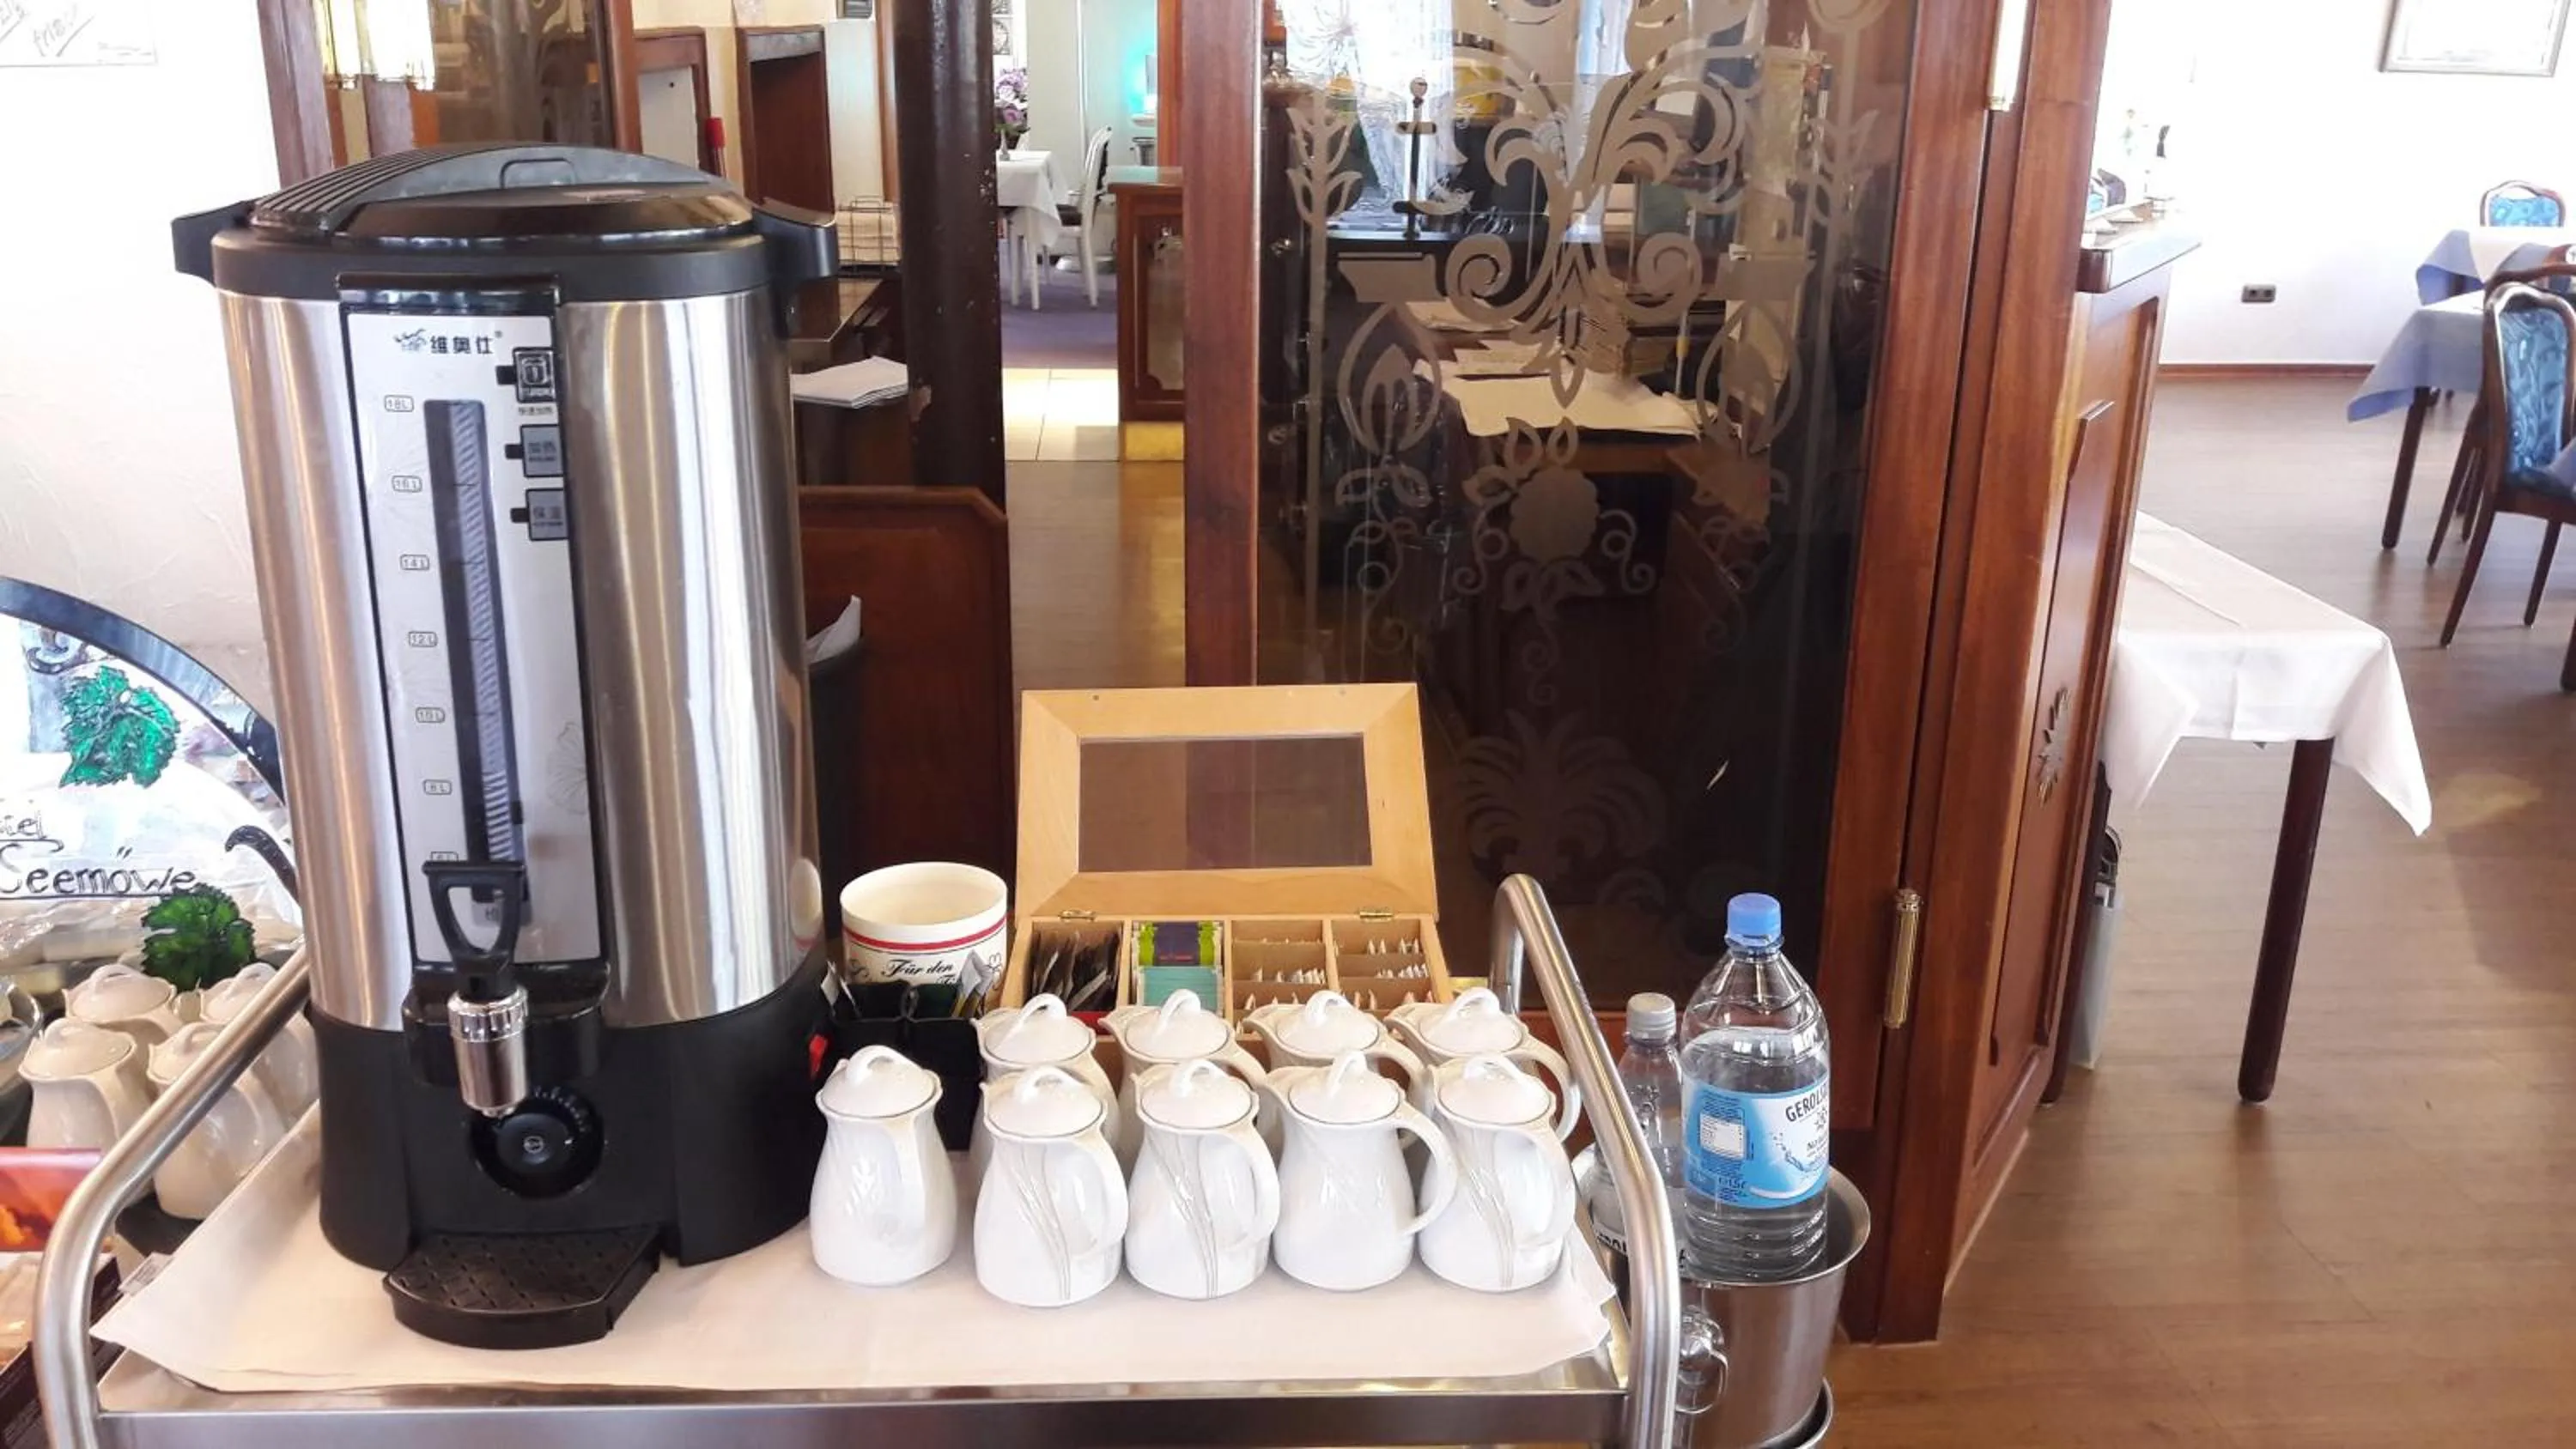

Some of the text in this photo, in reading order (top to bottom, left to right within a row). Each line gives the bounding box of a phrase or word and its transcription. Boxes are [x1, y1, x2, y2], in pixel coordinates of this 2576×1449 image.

[430, 336, 494, 354] 维奥仕
[881, 959, 953, 977] Für den
